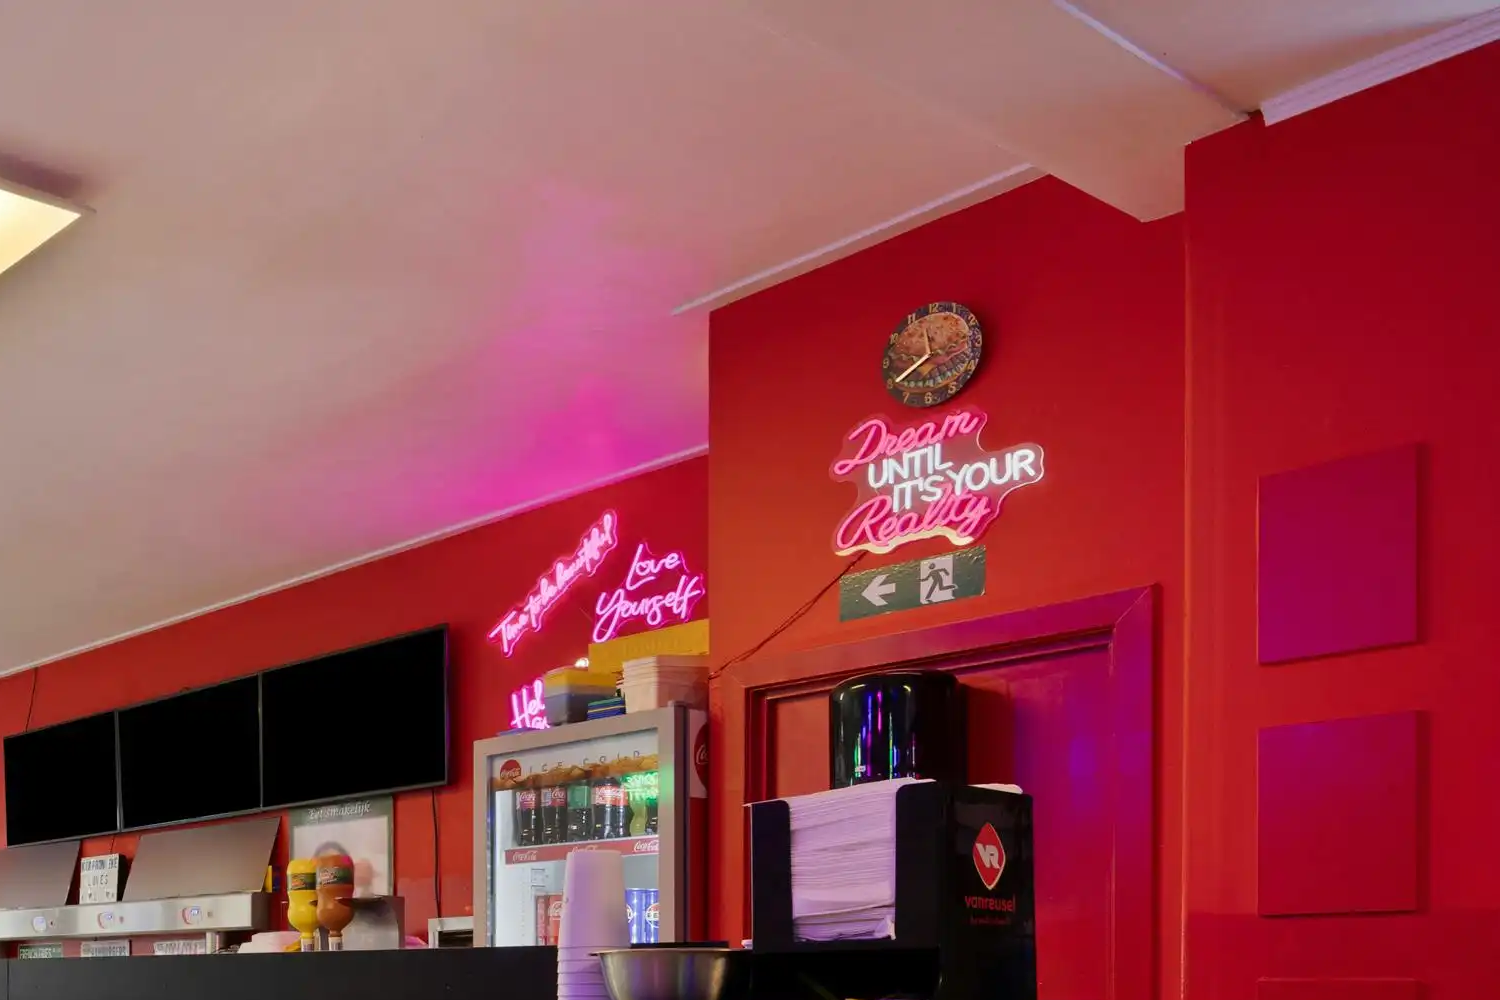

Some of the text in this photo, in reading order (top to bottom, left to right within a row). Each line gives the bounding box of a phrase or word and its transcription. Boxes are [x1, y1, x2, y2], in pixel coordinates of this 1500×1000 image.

[834, 411, 978, 474] Dream
[867, 442, 954, 489] UNTIL
[891, 448, 1036, 513] IT'S YOUR
[836, 483, 992, 547] Reality
[626, 543, 680, 590] Love
[593, 573, 703, 643] Yourself
[964, 894, 1016, 913] vanreusel
